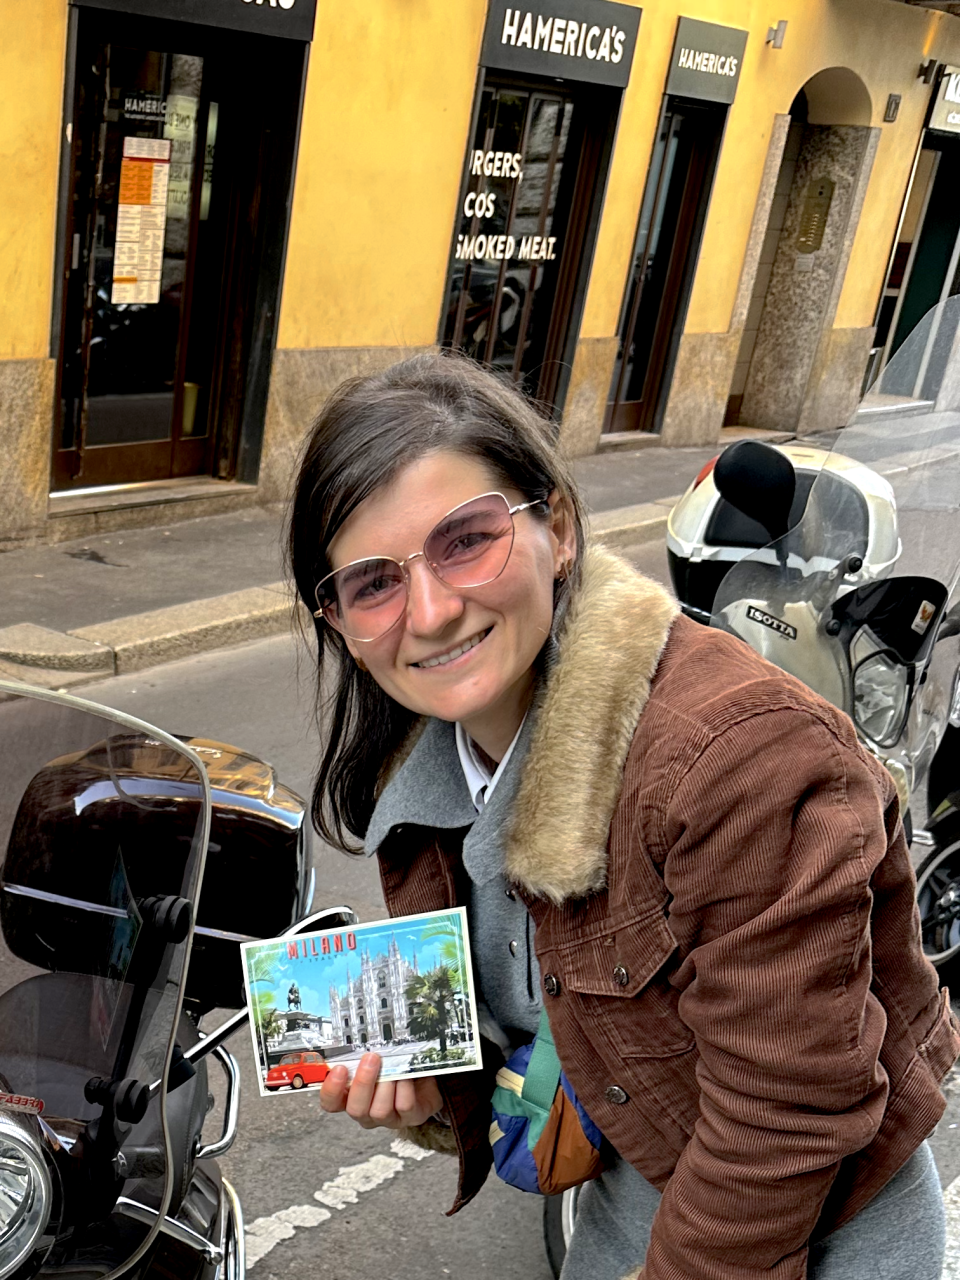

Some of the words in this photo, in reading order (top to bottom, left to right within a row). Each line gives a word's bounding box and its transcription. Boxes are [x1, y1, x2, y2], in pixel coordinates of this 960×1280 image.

[501, 8, 626, 64] HAMERICA'S
[678, 47, 738, 77] HAMERICA'S
[469, 149, 524, 185] RGERS,
[463, 191, 497, 218] COS
[518, 235, 557, 260] MEAT.
[749, 608, 795, 638] ISOTTA
[286, 932, 357, 960] MILANO
[309, 953, 338, 963] ITALY
